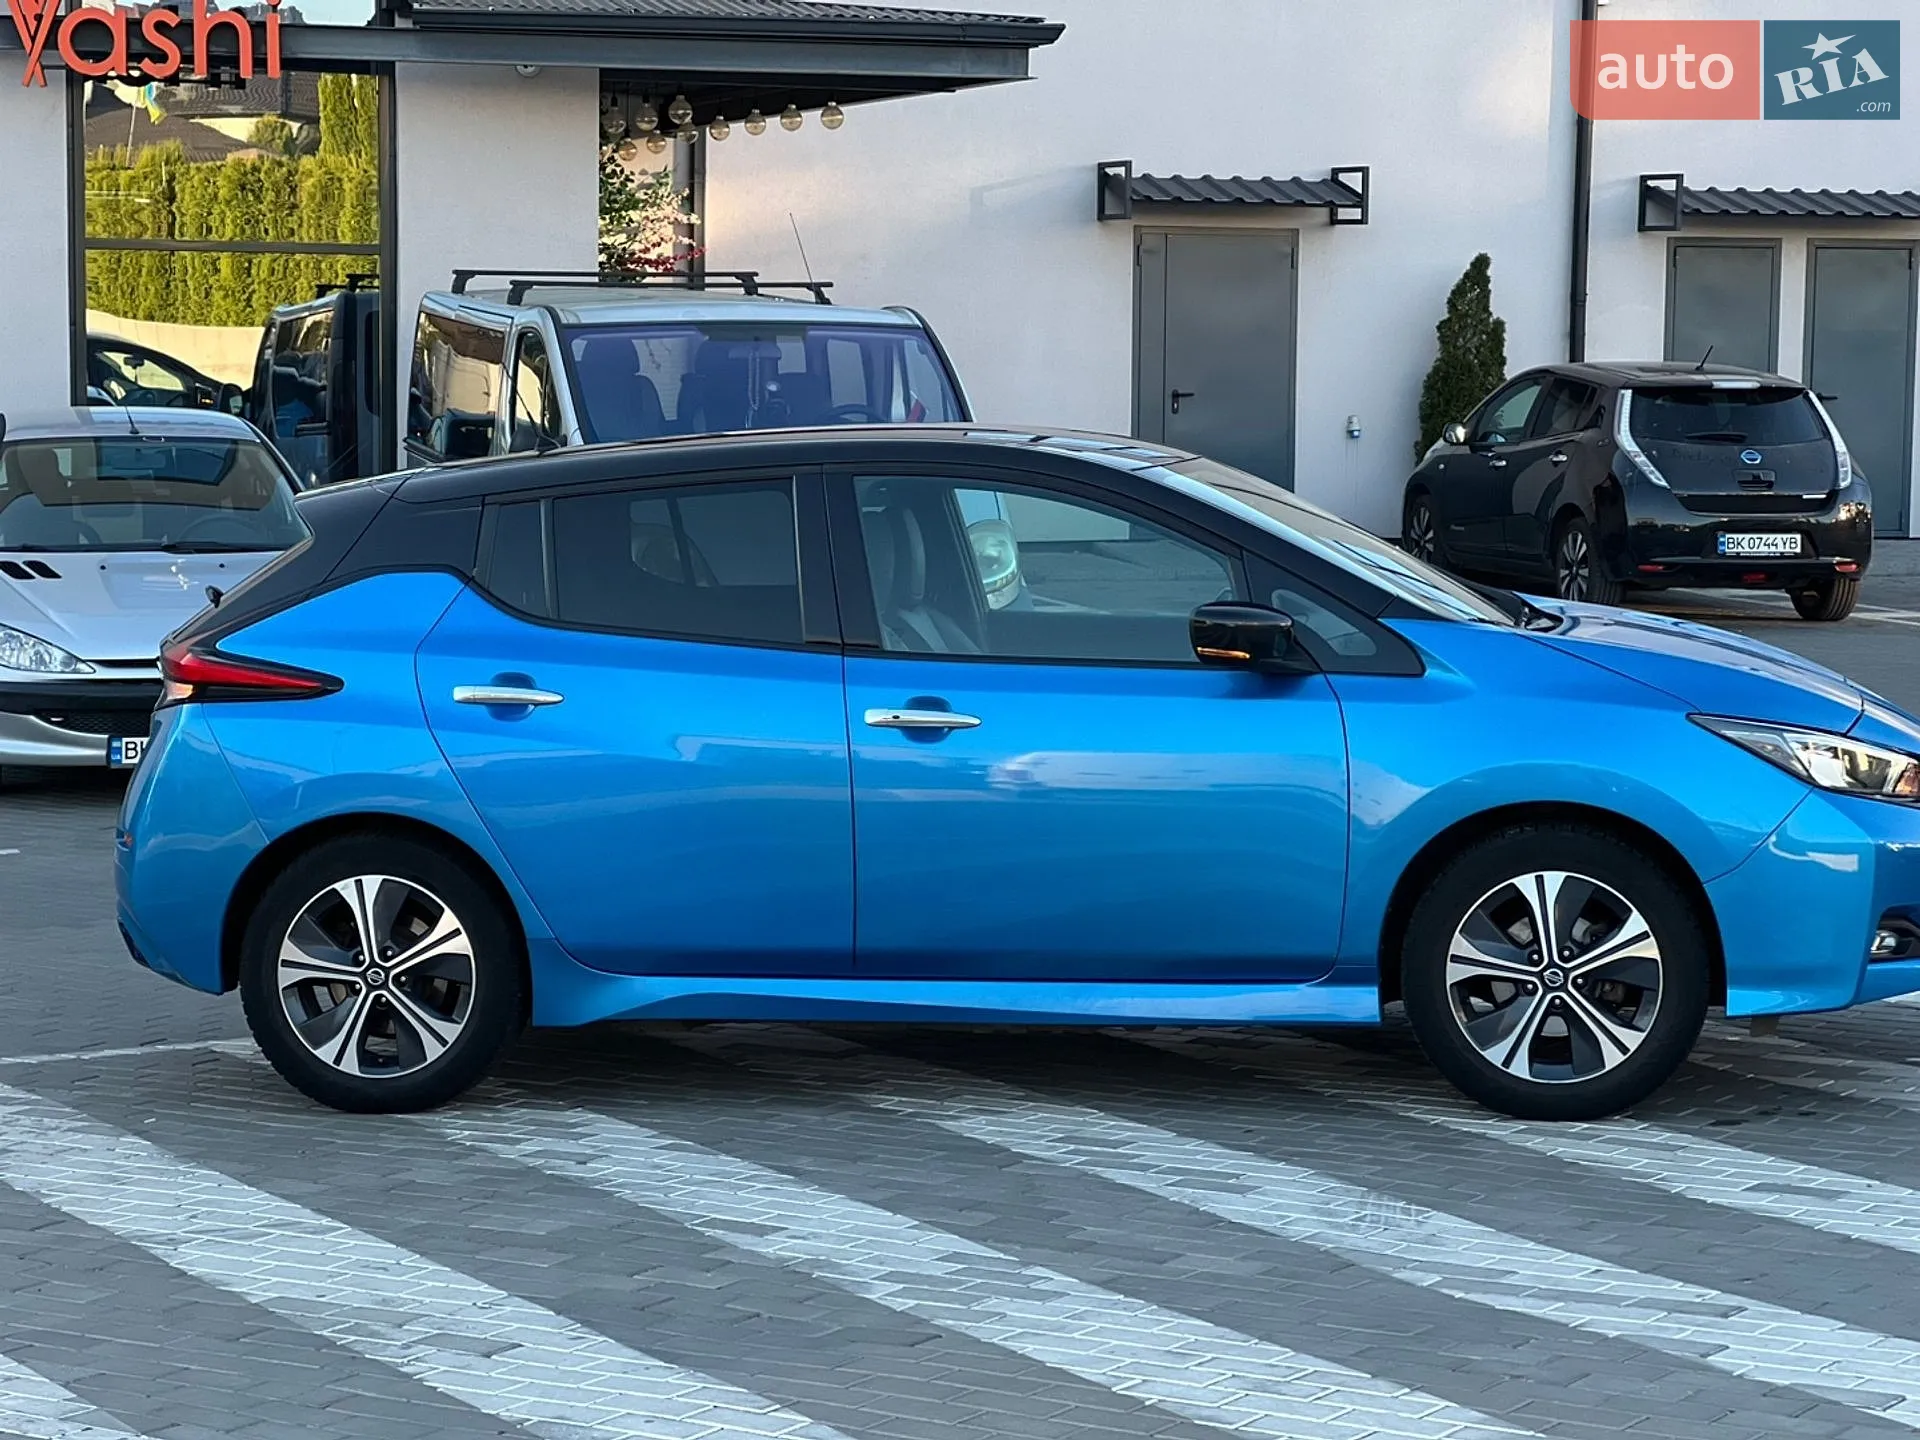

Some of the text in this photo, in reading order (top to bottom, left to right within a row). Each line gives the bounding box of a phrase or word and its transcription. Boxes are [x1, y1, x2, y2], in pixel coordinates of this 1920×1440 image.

[1726, 537, 1799, 550] BK 0744 YB
